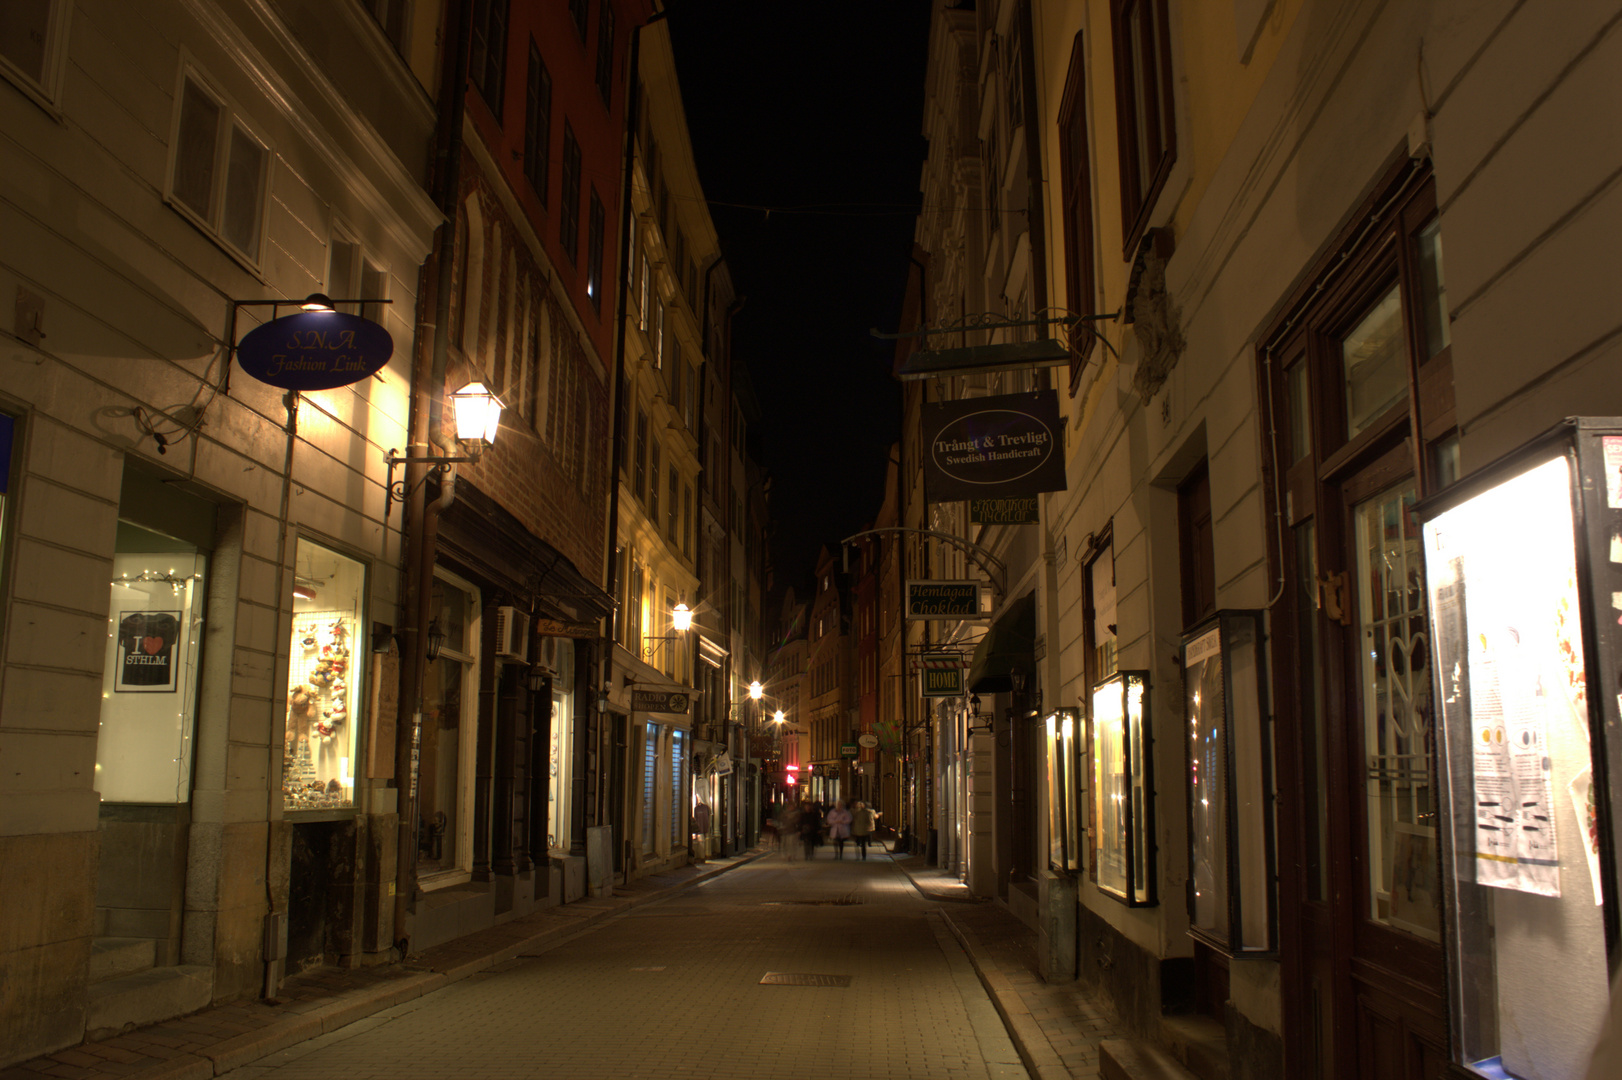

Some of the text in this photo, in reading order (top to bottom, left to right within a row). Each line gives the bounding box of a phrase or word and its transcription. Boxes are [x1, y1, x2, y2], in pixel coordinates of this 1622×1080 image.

[286, 330, 358, 350] S.N.A.
[266, 354, 367, 377] Fashion Link
[936, 431, 1048, 453] Trångt & Trevligt
[946, 446, 1041, 465] Swedish Handicraft
[911, 585, 974, 601] Hemlagad
[910, 599, 974, 615] Choklad
[131, 635, 143, 655] I
[929, 672, 957, 690] HOME
[635, 693, 667, 703] RADIO
